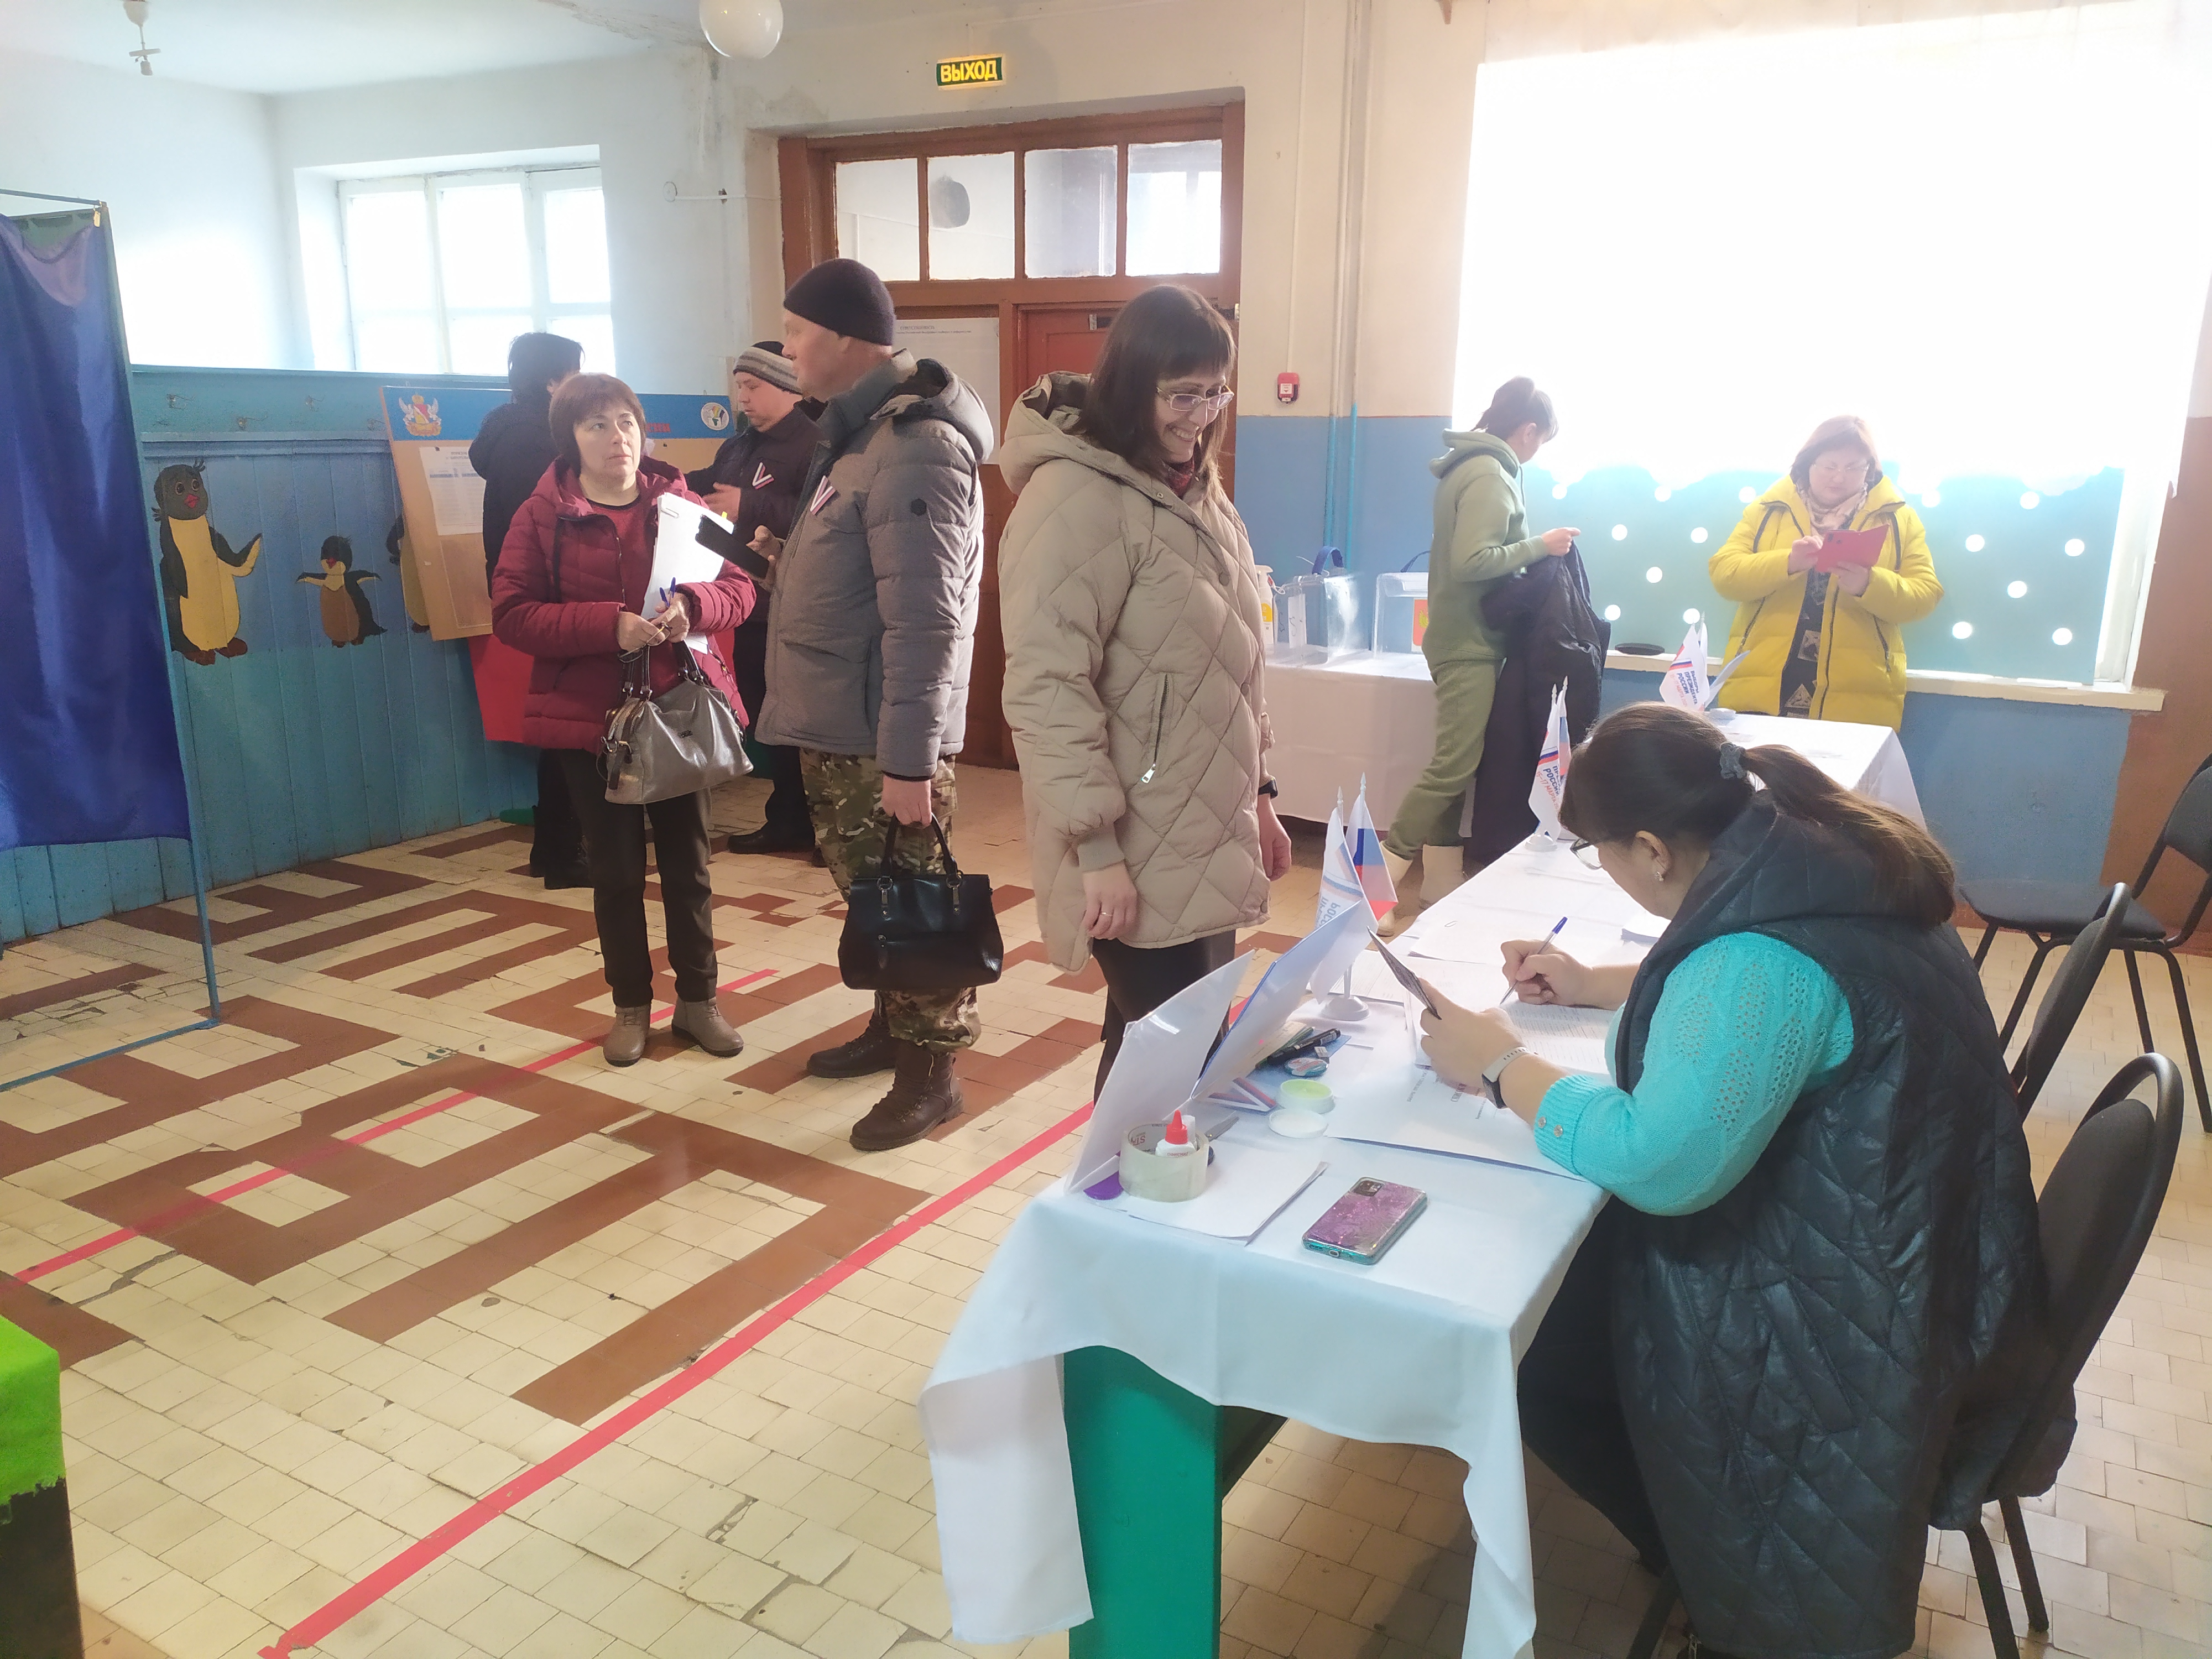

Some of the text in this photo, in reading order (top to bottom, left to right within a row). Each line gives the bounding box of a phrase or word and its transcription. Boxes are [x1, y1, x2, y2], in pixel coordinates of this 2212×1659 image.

[940, 59, 998, 82] ВЫХОД
[1677, 672, 1689, 694] РОССИИ
[1684, 671, 1698, 705] ПРЕЗИДЕНТА
[1691, 670, 1699, 693] ВЫБОРЫ
